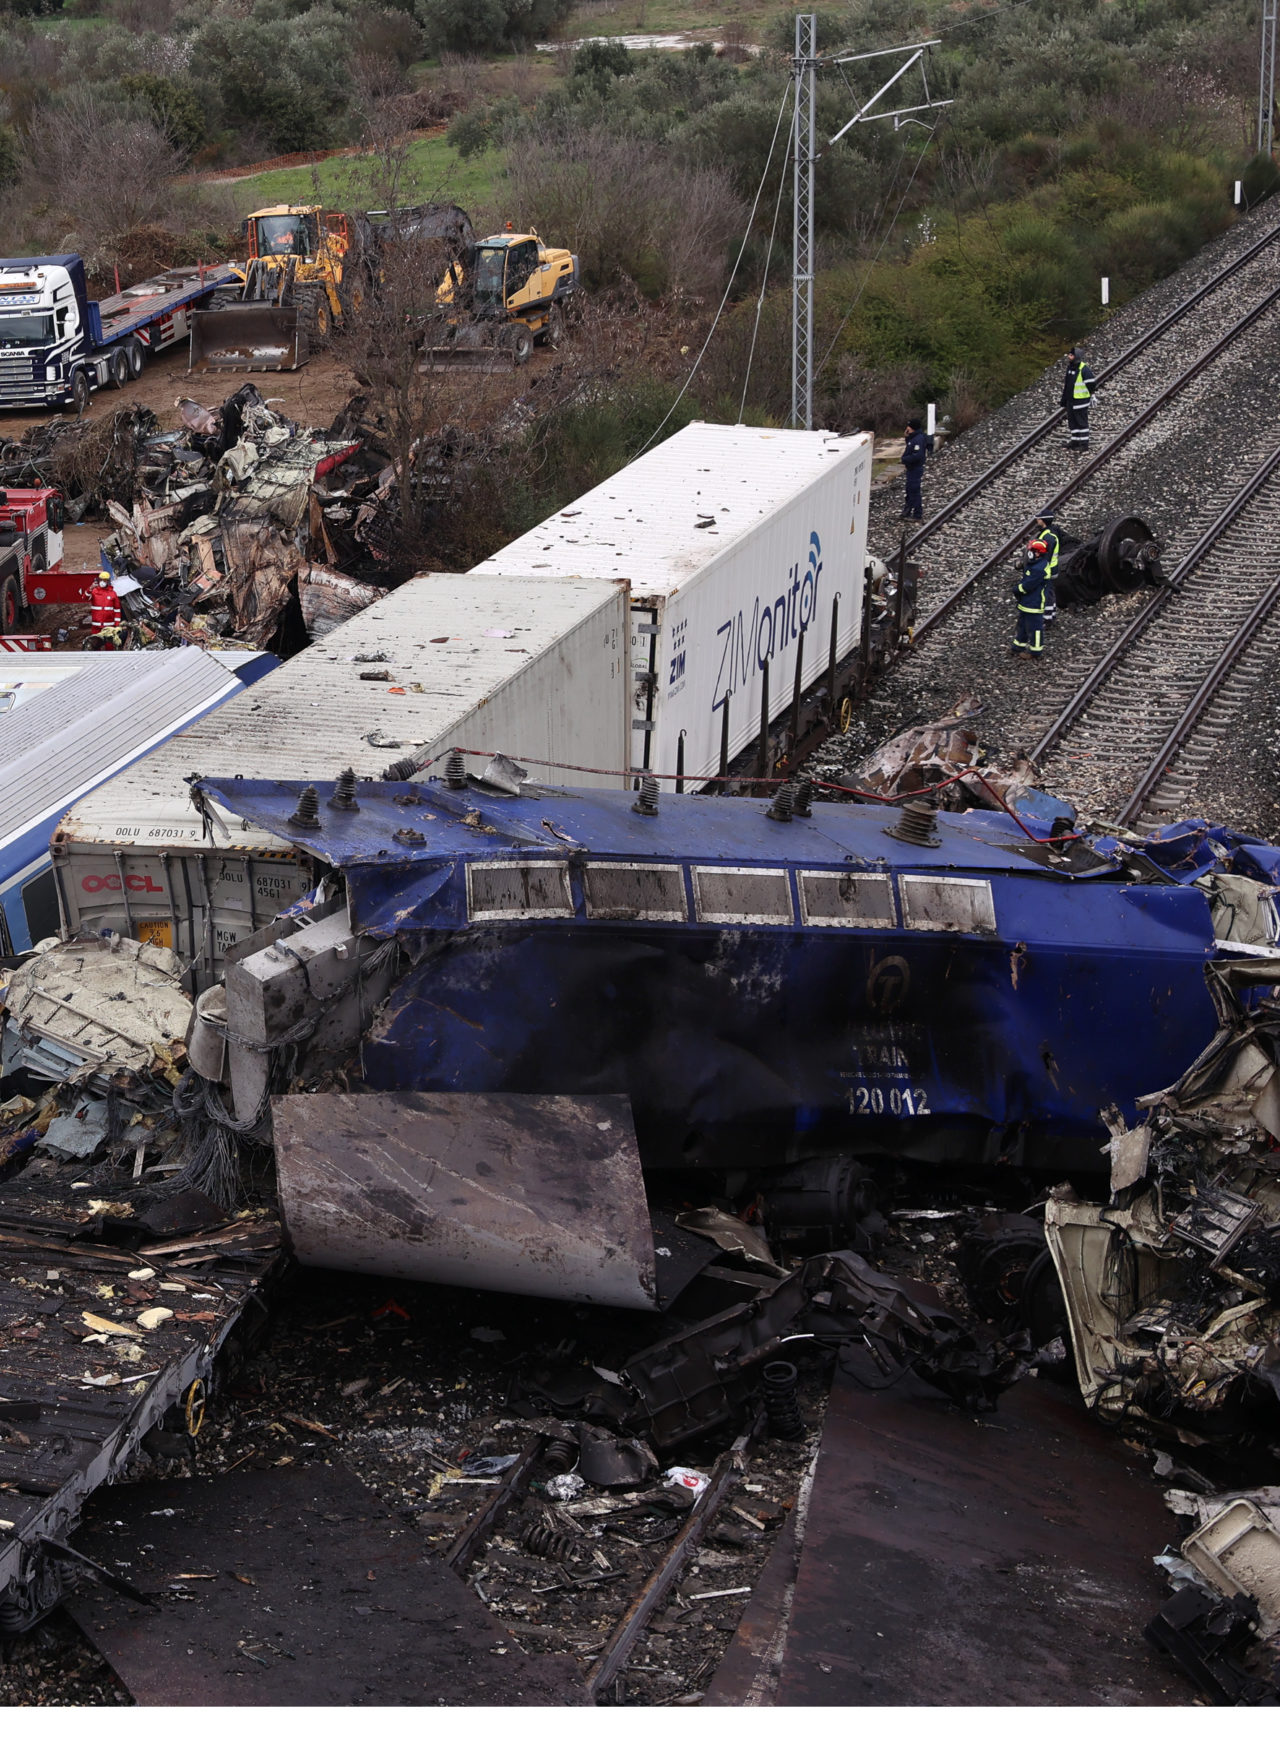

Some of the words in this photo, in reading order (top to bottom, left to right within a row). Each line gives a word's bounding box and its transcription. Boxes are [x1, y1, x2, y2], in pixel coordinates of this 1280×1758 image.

[712, 562, 822, 712] ZIMonitor
[669, 649, 686, 685] ZIM
[115, 827, 140, 836] OOLU
[148, 828, 184, 838] 687031
[190, 830, 196, 838] 9
[81, 874, 164, 893] OOCL
[257, 877, 291, 889] 687031
[257, 888, 280, 899] 45G1
[216, 930, 236, 942] MGW
[845, 1087, 884, 1115] 120
[890, 1088, 931, 1115] 012
